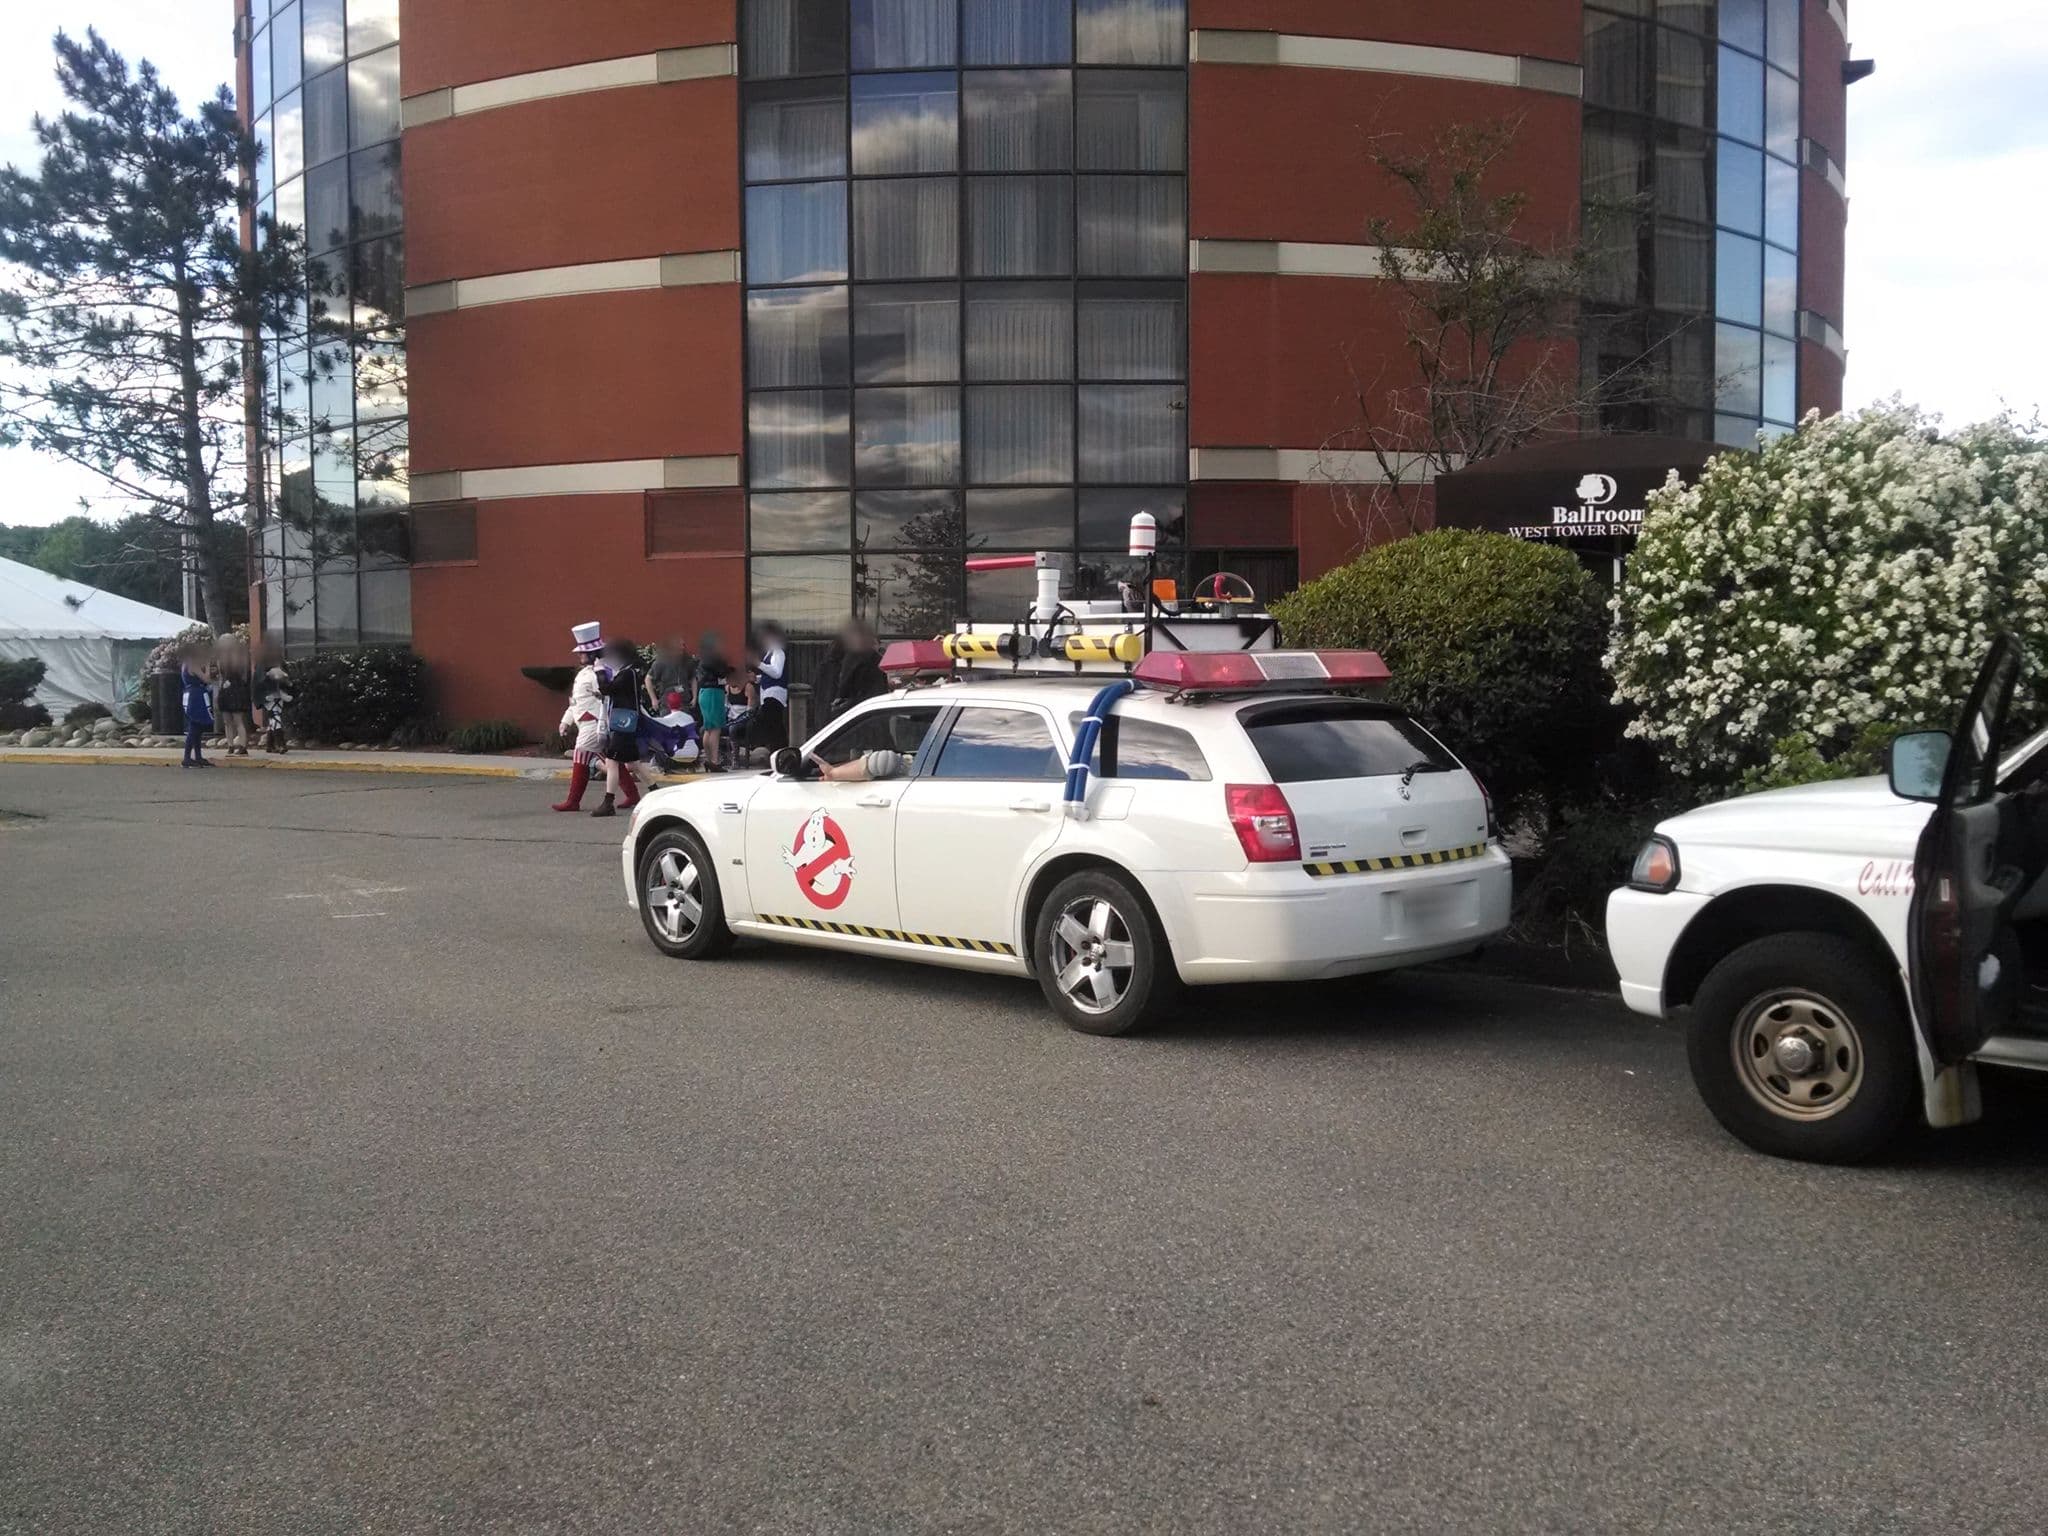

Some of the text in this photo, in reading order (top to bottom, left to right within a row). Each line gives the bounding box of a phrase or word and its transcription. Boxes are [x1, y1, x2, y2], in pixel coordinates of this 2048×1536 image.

[1509, 526, 1551, 538] WEST
[1553, 524, 1606, 537] TOWER
[1858, 860, 1902, 896] Call
